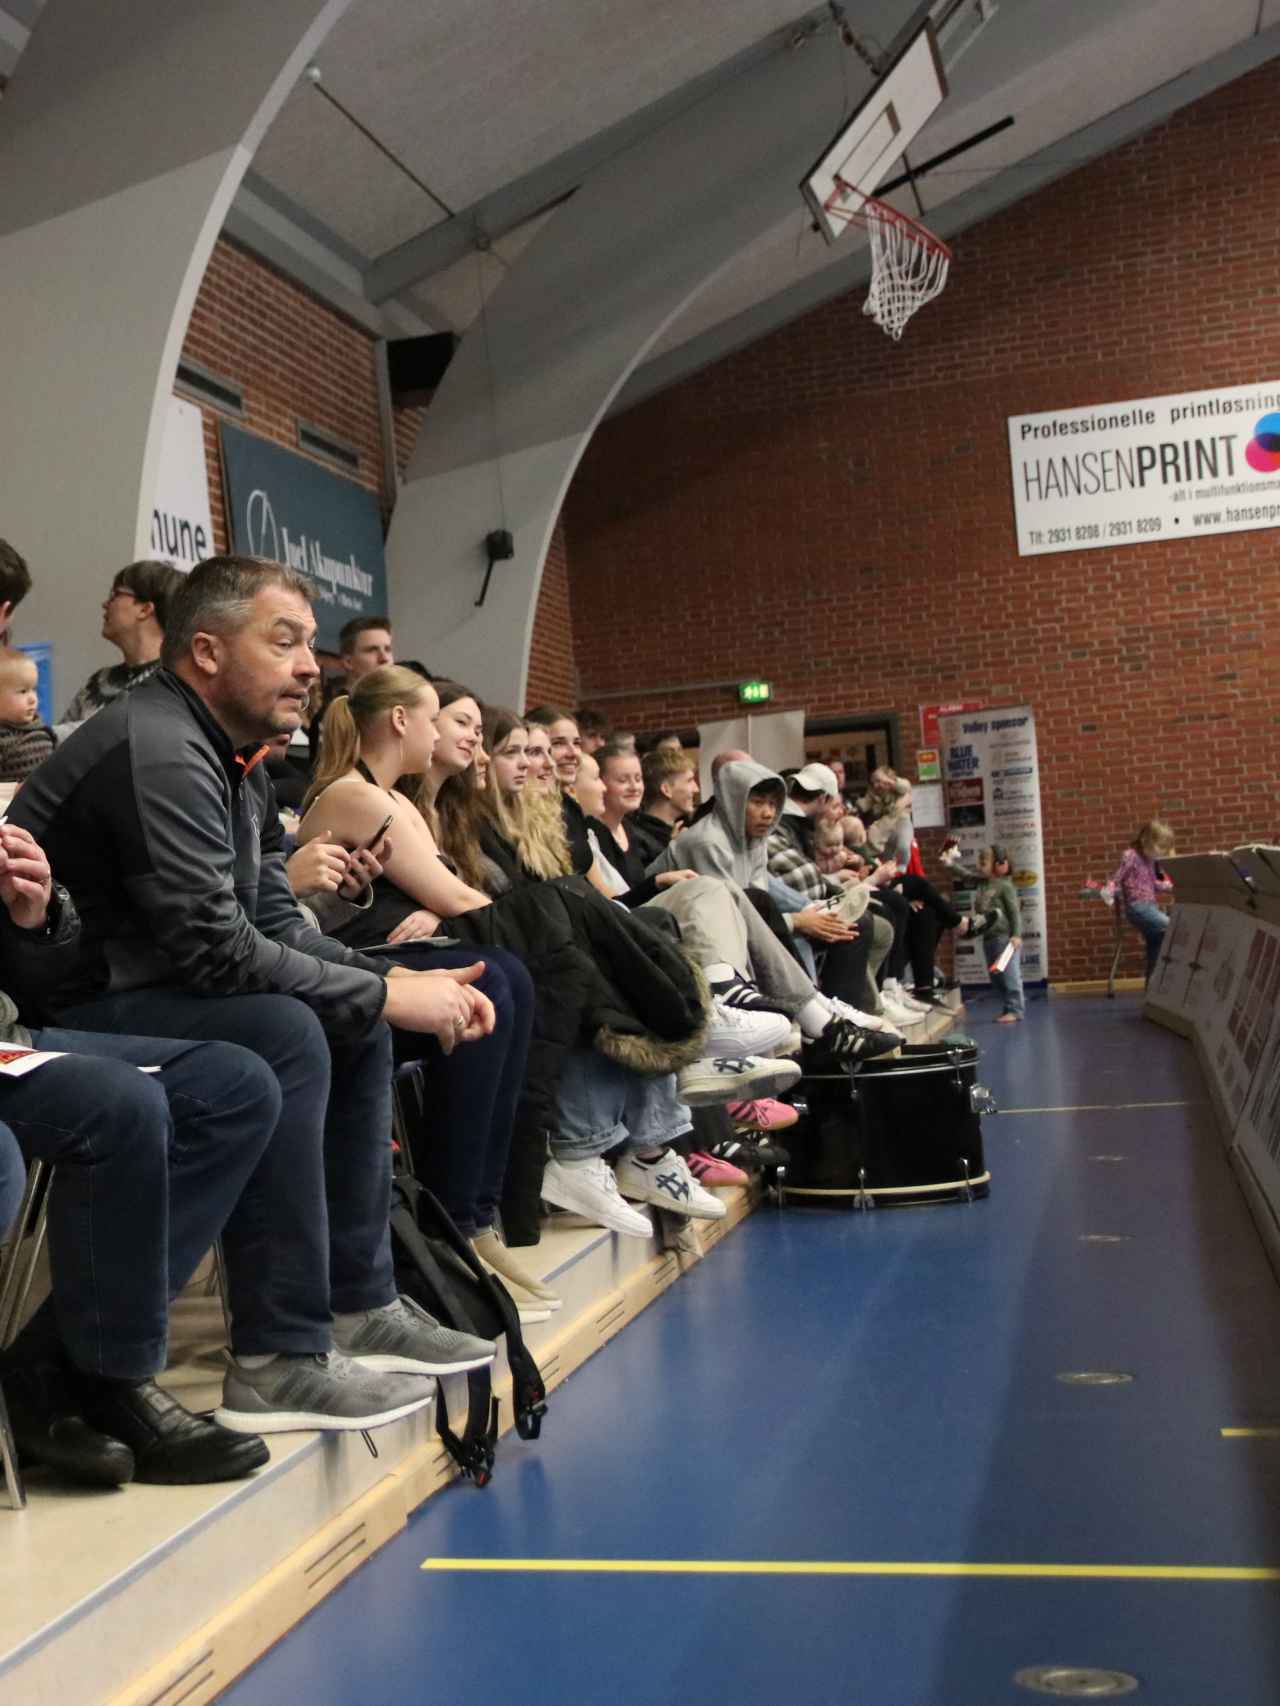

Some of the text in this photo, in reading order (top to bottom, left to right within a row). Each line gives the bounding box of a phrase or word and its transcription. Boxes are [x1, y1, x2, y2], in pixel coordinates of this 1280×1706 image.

[1020, 408, 1156, 440] Professionelle
[1023, 434, 1238, 502] HANSENPRINT
[1047, 527, 1071, 544] 2931
[1108, 519, 1132, 536] 2931
